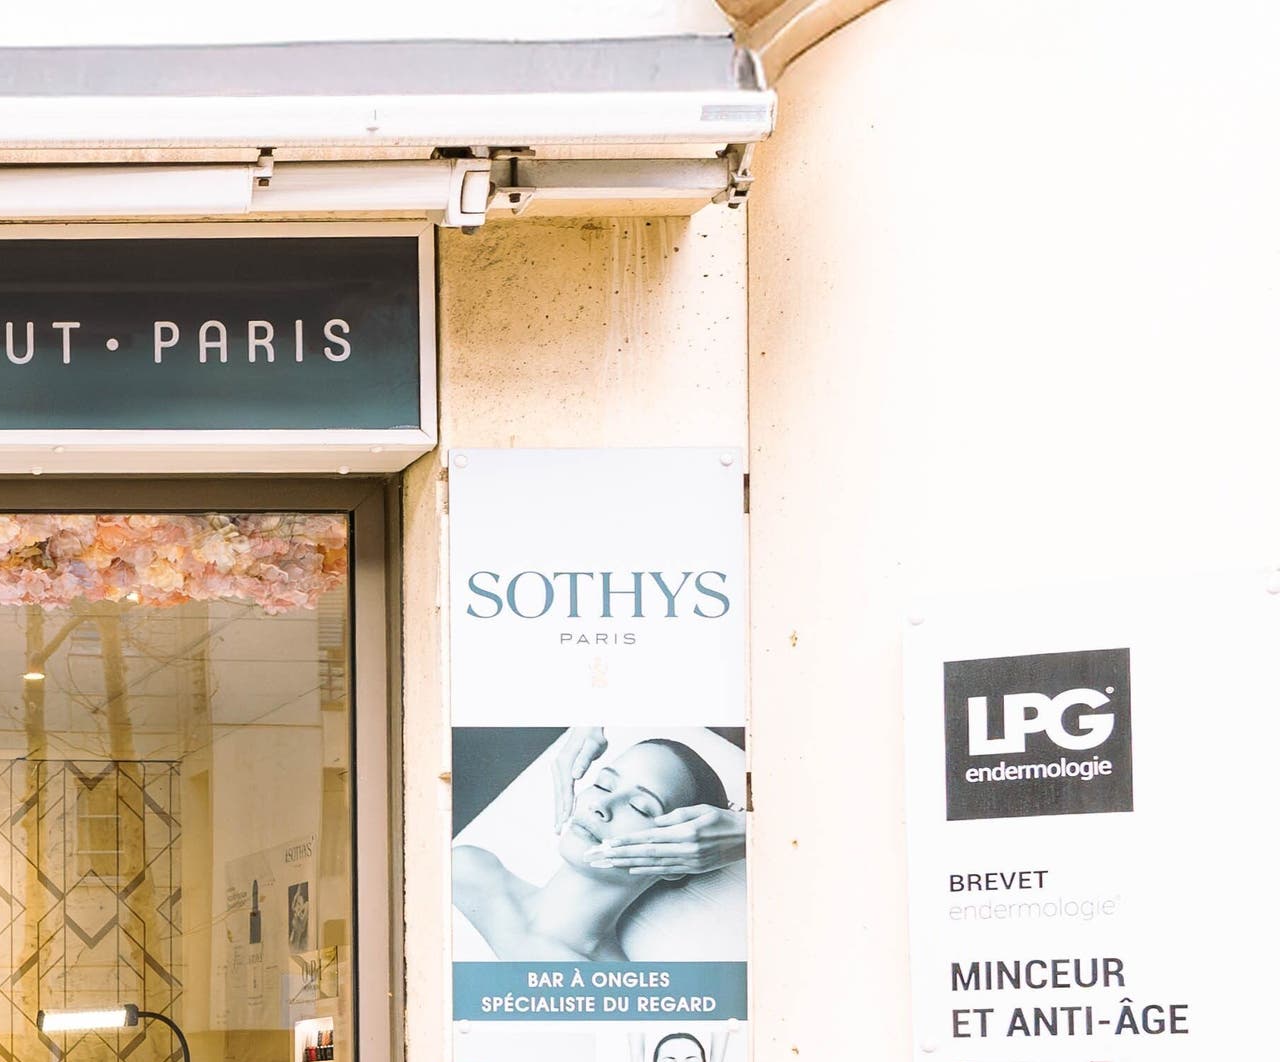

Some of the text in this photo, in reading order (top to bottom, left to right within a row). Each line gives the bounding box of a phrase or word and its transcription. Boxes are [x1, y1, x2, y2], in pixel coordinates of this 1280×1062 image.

[153, 318, 352, 363] PARIS
[466, 570, 731, 619] SOTHYS
[559, 632, 637, 646] PARIS
[965, 755, 1112, 783] endermologie
[948, 870, 1049, 893] BREVET
[527, 967, 671, 988] BAR À ONGLES
[950, 957, 1126, 992] MINCEUR
[481, 992, 717, 1013] SPÉCIALISTE DU REGARD
[951, 996, 1190, 1039] ET ANTI-ÂGE
